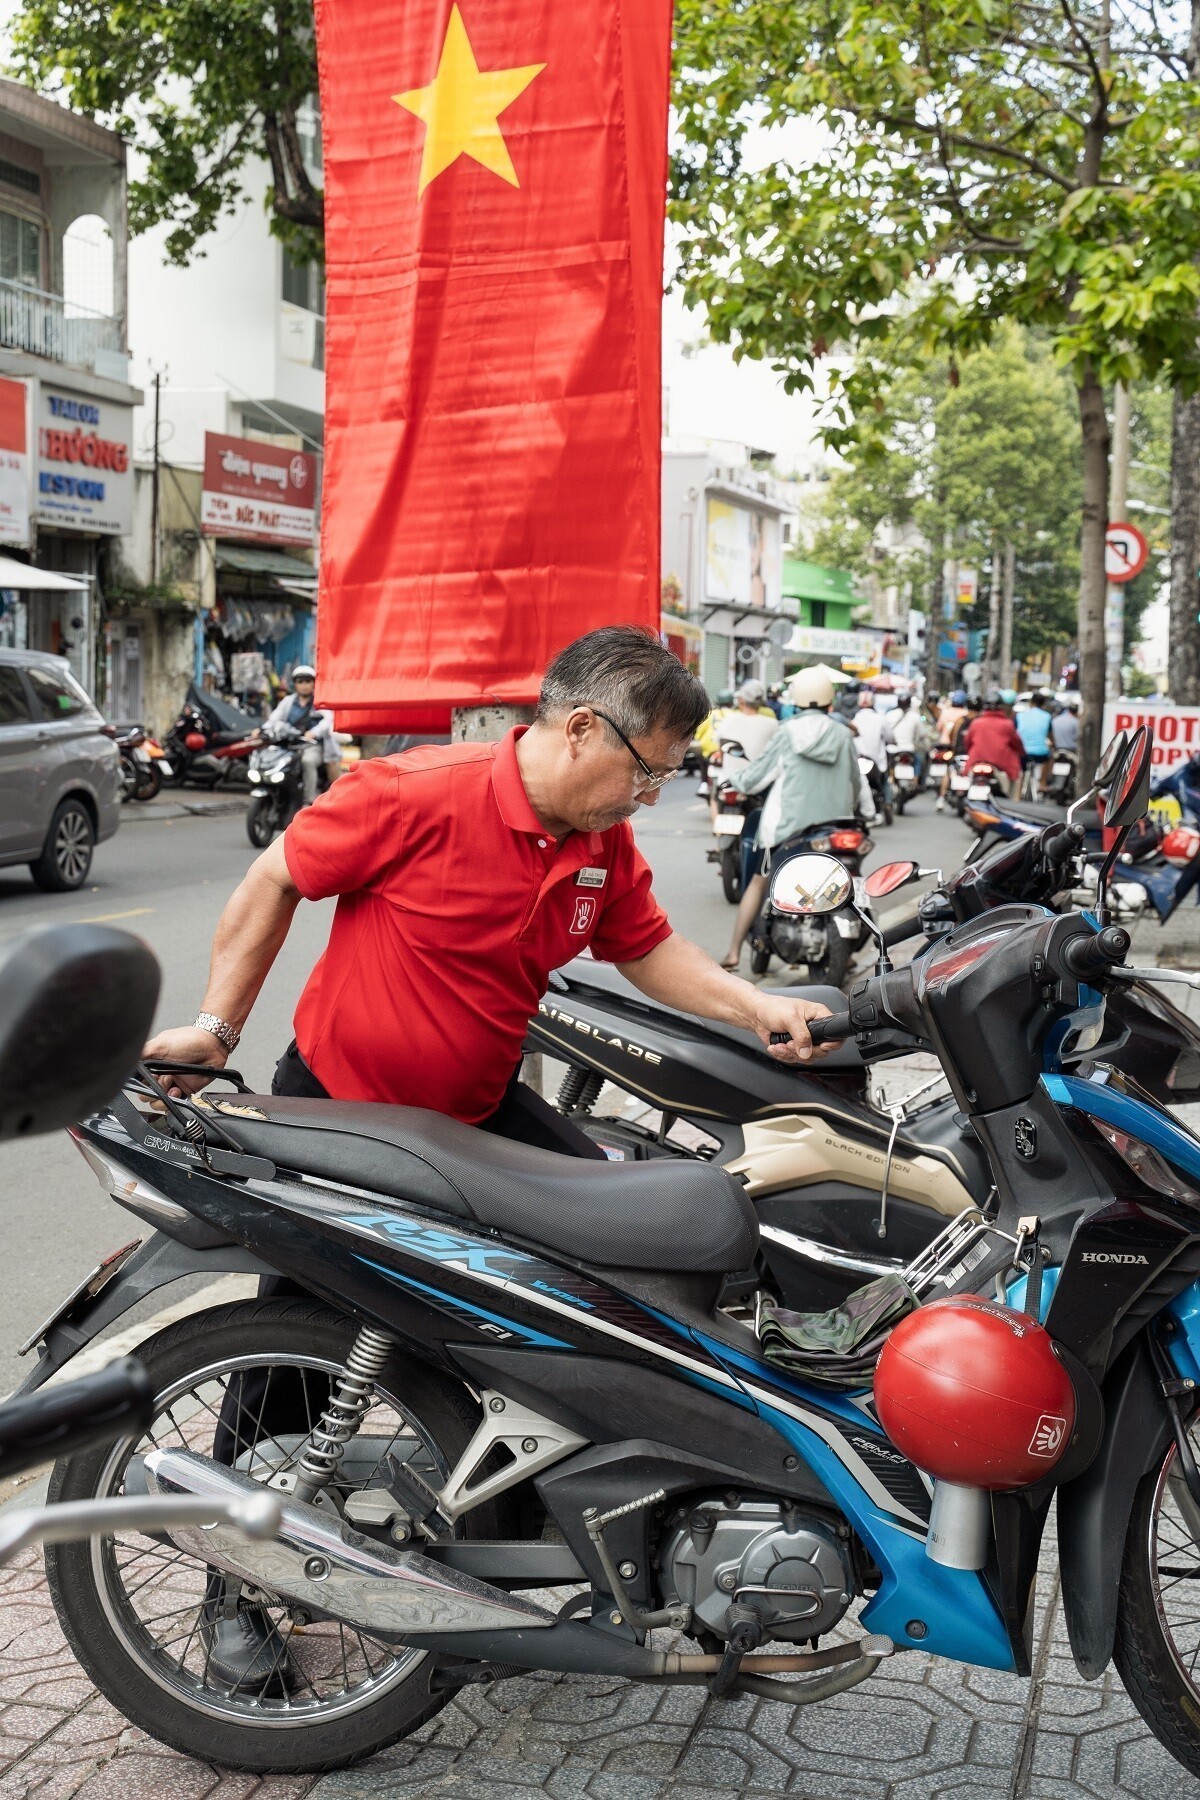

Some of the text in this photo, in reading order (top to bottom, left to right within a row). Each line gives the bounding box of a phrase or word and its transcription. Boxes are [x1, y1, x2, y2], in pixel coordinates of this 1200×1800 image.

[825, 1138, 911, 1174] BLACK EDIION
[1081, 1252, 1150, 1265] HONDA
